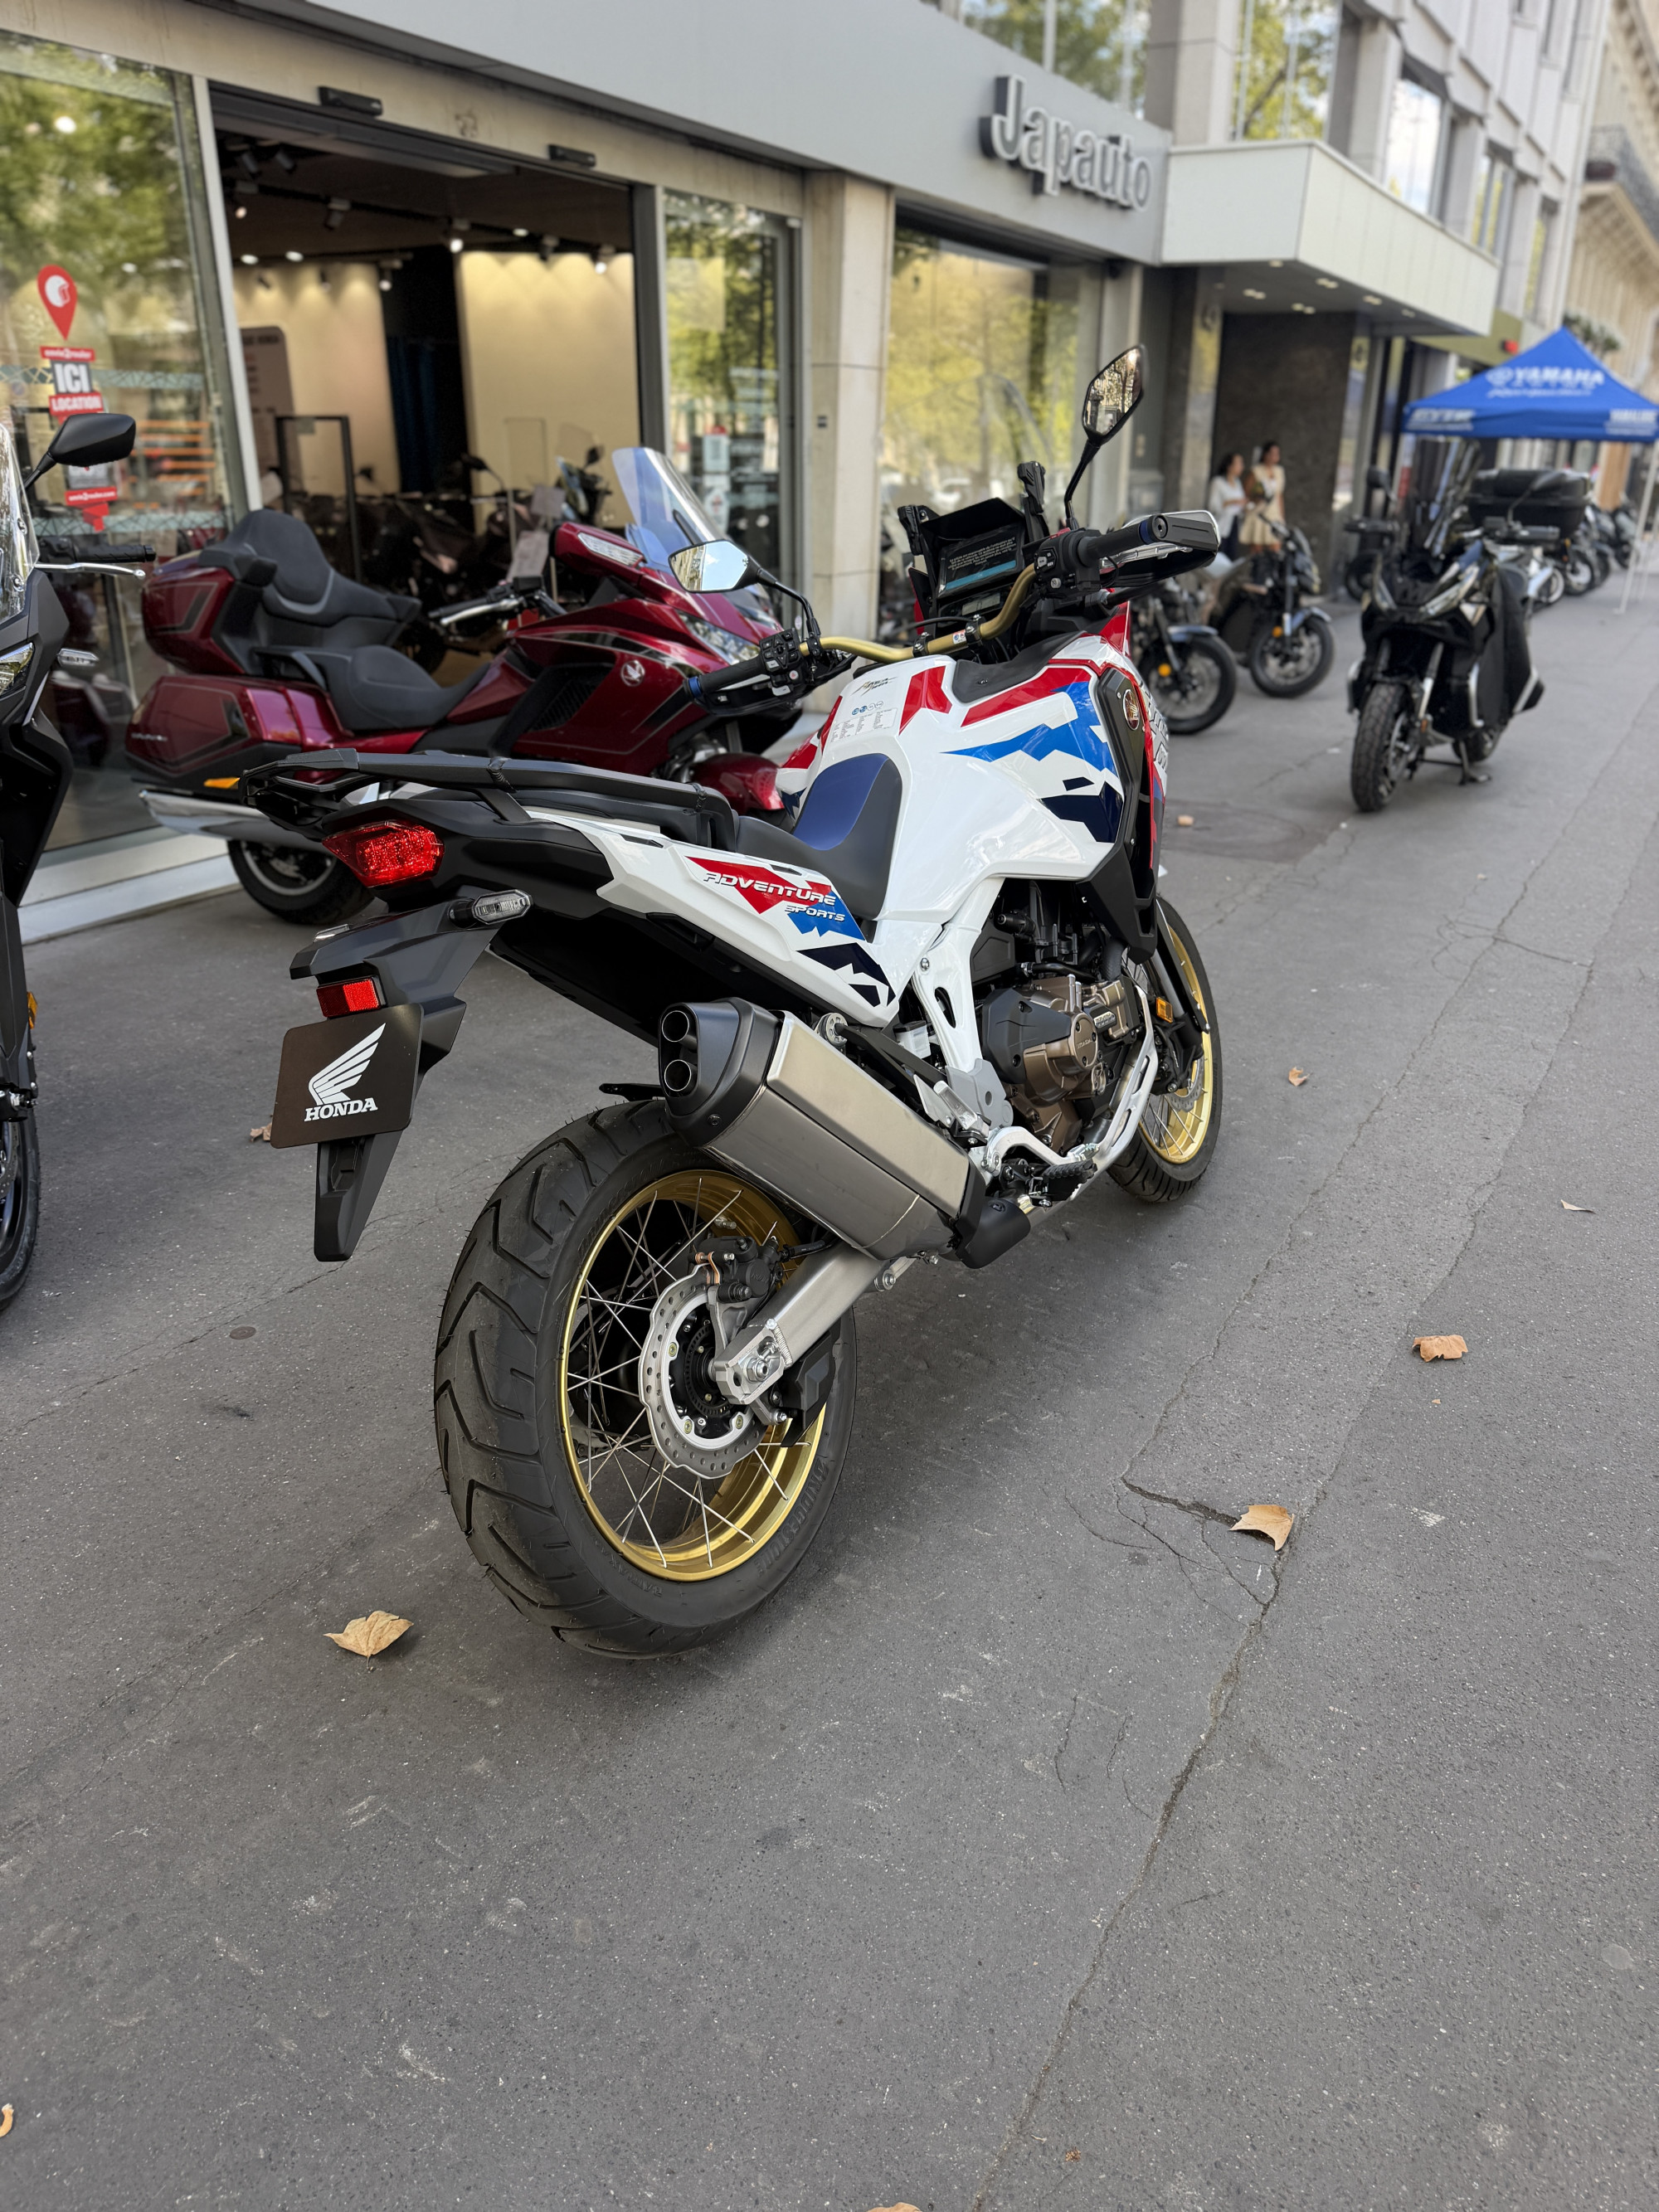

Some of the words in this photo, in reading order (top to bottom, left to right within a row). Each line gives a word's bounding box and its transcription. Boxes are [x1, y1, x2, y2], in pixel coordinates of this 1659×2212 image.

[982, 73, 1151, 212] Japauto
[53, 362, 92, 393] ICI
[1514, 367, 1605, 386] YAMAHA
[51, 396, 103, 412] LOCATION
[703, 872, 837, 906] ADVENTURE
[784, 904, 846, 922] SPORTS
[304, 1096, 379, 1122] HONDA
